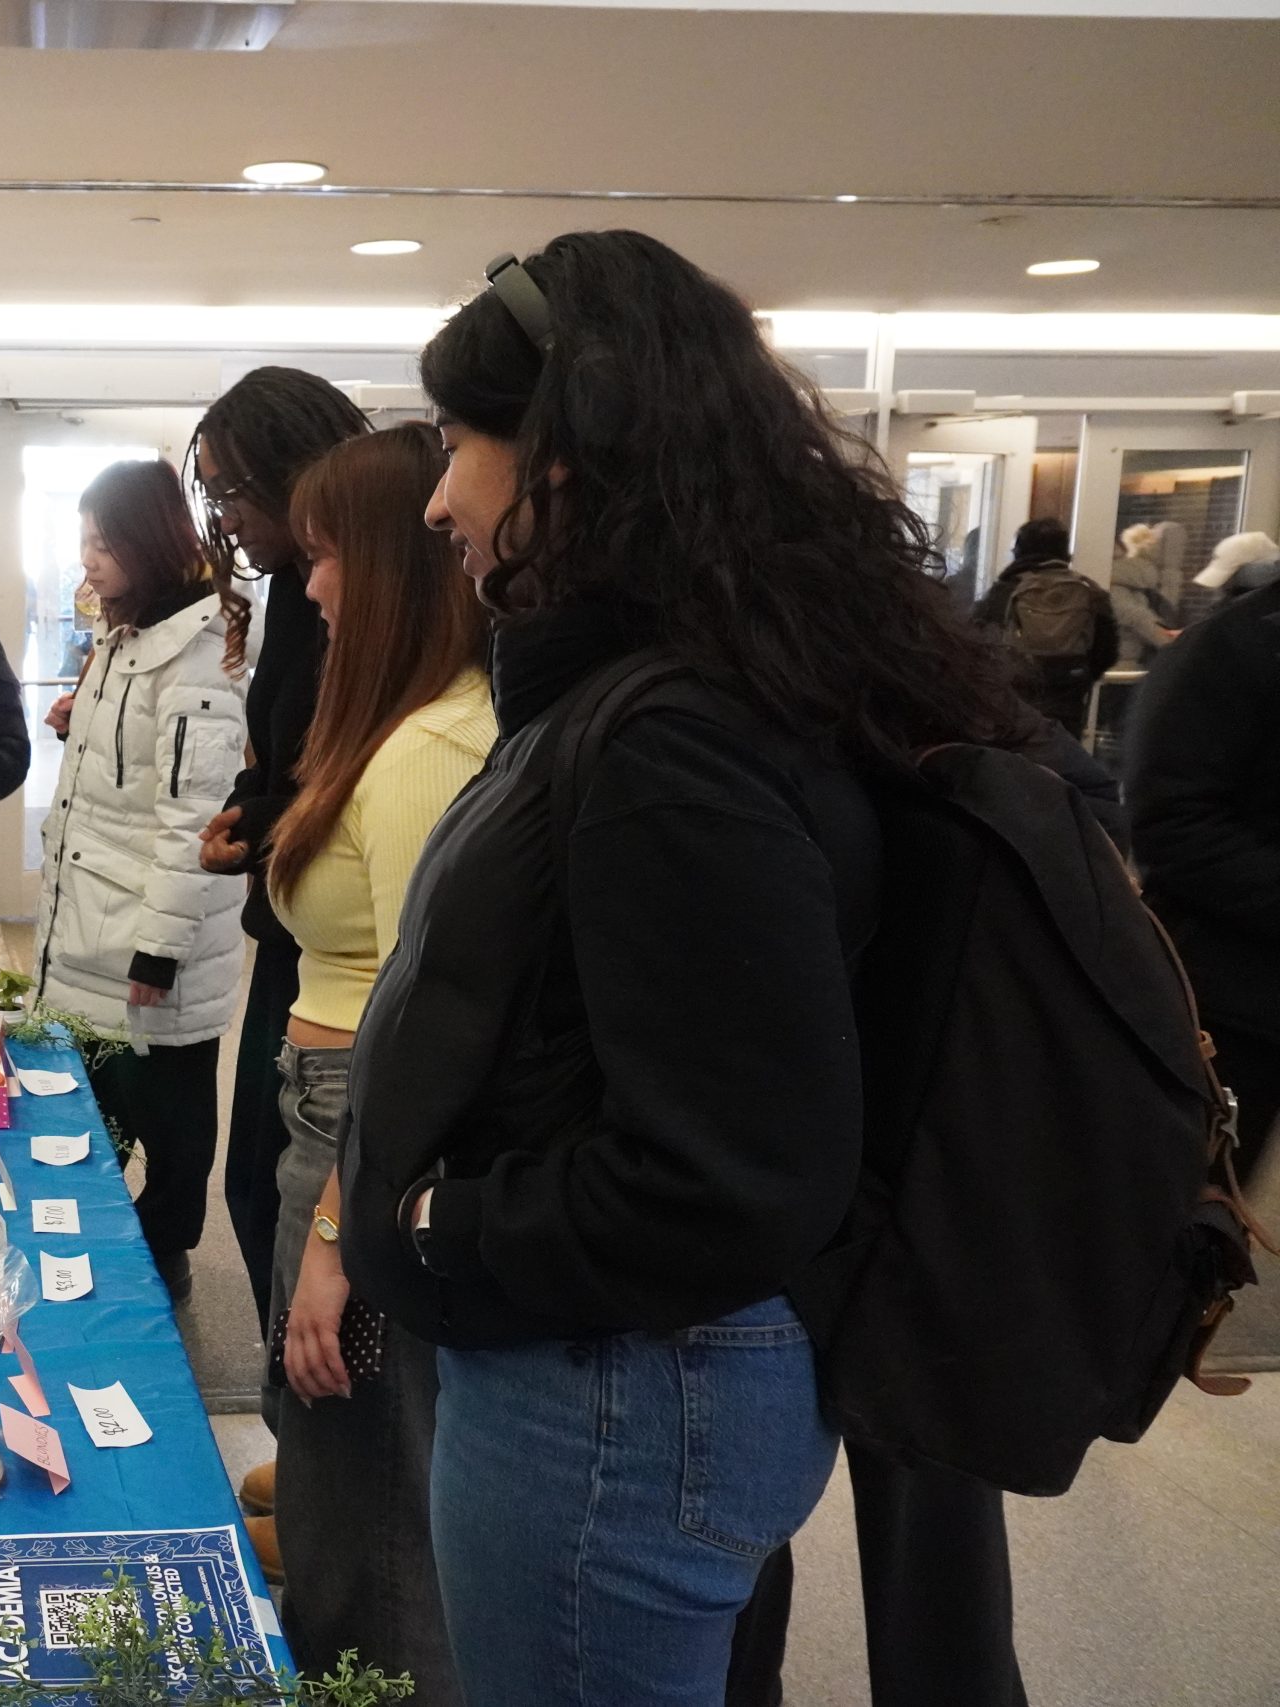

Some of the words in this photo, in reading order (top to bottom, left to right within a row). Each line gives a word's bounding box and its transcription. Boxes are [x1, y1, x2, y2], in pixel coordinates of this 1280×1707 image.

[55, 1269, 78, 1292] $3.00
[93, 1407, 129, 1436] $2.00
[34, 1422, 51, 1467] BLONDIES
[143, 1553, 160, 1564] &
[146, 1565, 162, 1579] US
[149, 1574, 169, 1626] FOLLOW
